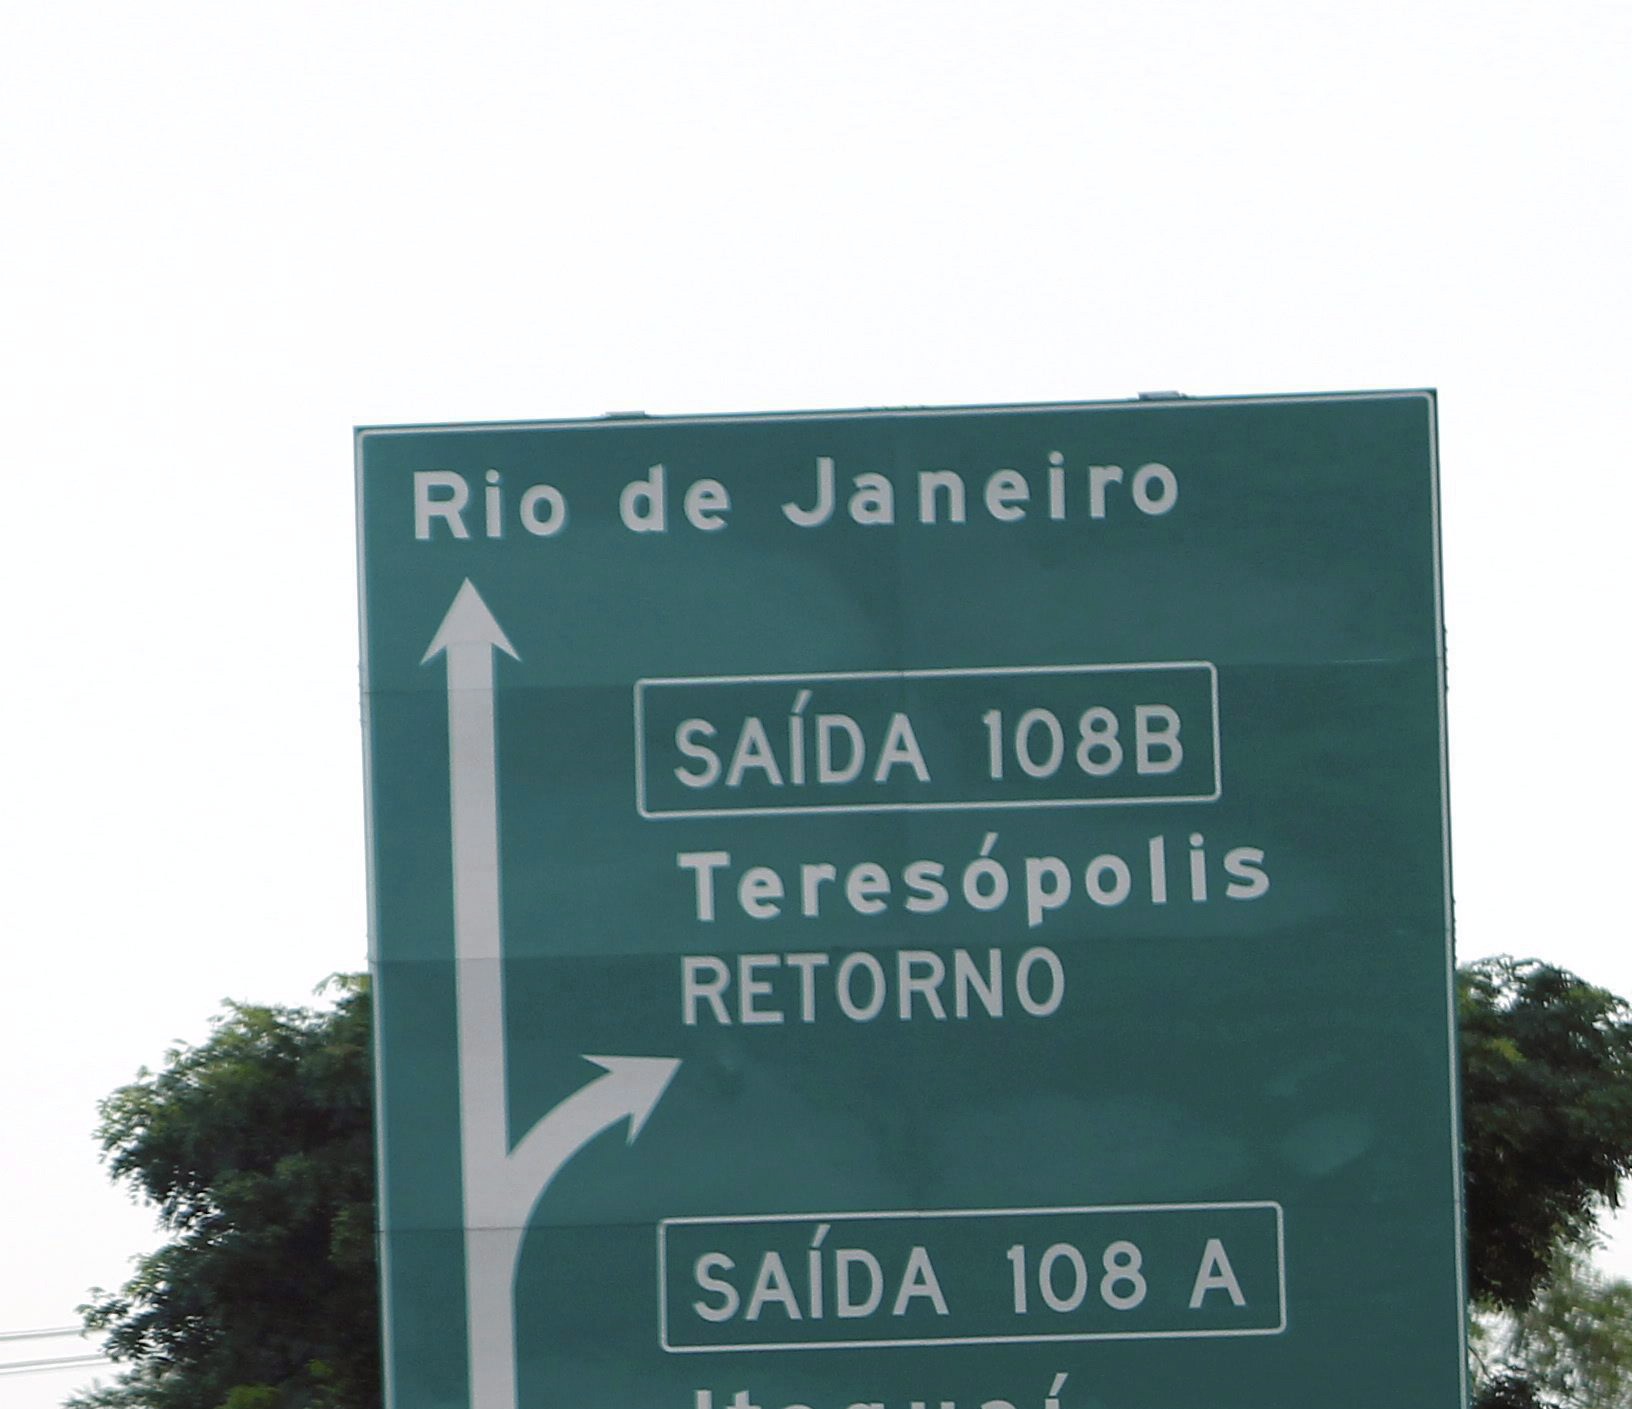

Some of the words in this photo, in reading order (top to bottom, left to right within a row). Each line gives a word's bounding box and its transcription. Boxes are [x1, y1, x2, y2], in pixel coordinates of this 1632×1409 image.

[413, 469, 567, 541] Rio
[619, 464, 731, 534] de
[782, 451, 1179, 527] Janeiro
[674, 689, 931, 788] SAÍDA
[982, 704, 1184, 778] 108B
[677, 832, 1271, 927] Teresópolis
[681, 947, 1066, 1025] RETORNO
[692, 1224, 950, 1323] SAÍDA
[1006, 1240, 1148, 1314] 108
[1189, 1239, 1247, 1309] A
